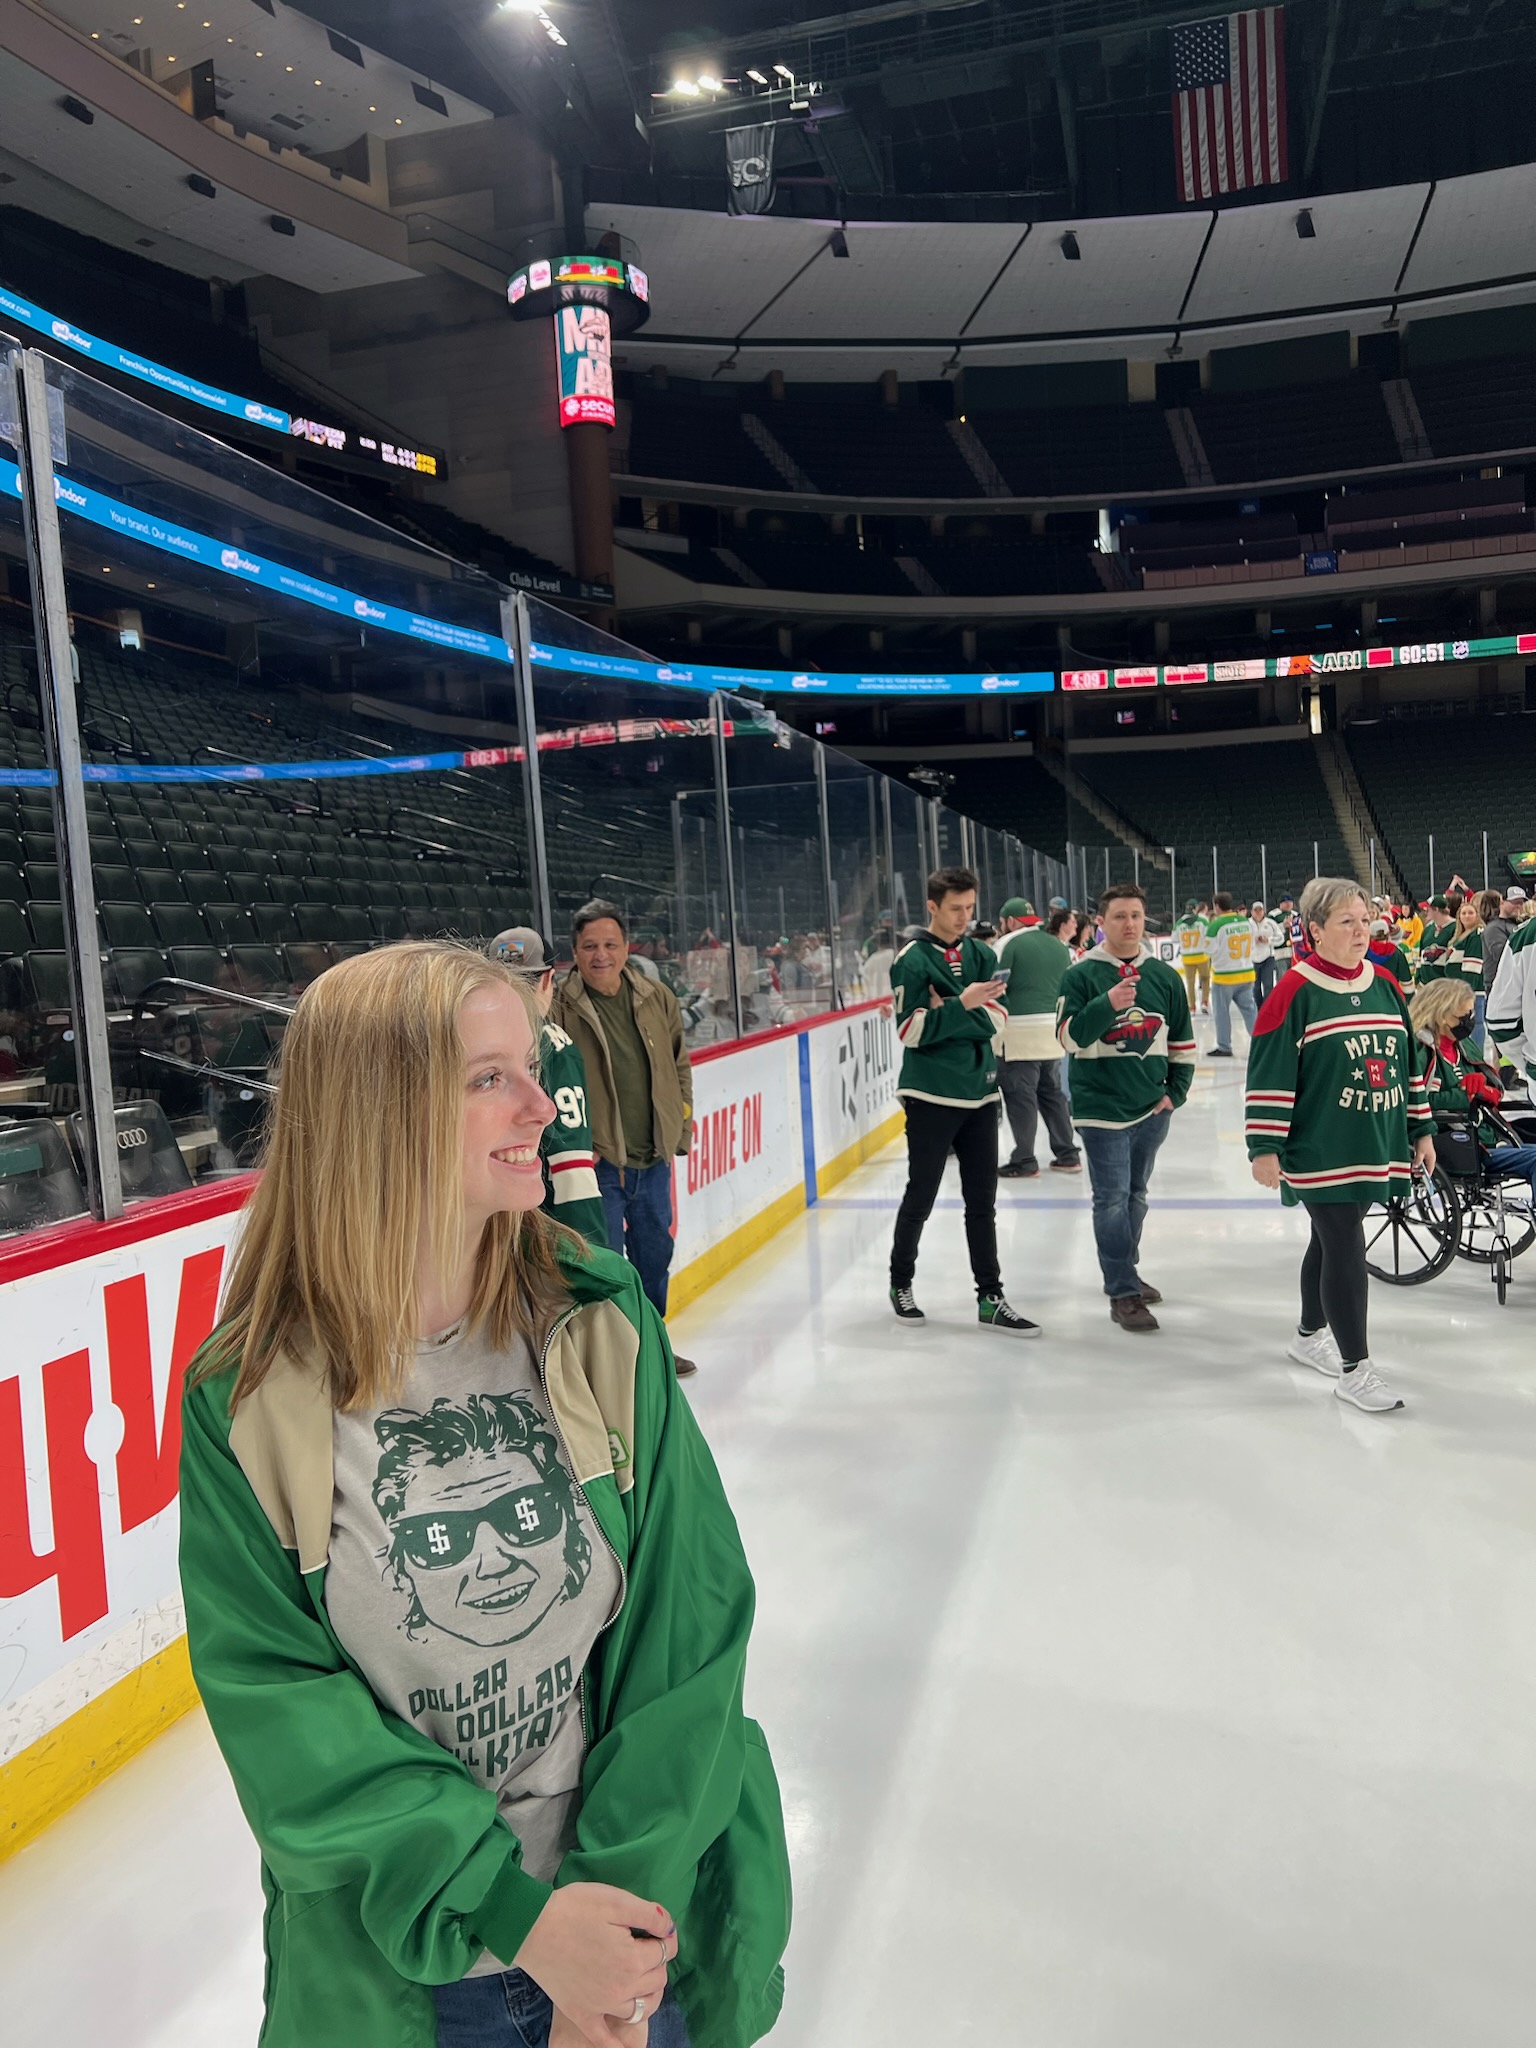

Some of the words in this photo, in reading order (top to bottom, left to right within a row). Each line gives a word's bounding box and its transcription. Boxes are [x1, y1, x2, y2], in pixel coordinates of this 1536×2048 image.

[109, 509, 127, 526] Your
[509, 572, 532, 587] Club
[532, 576, 562, 593] Level
[1180, 929, 1201, 948] 97
[1228, 933, 1252, 960] 97
[1344, 1033, 1399, 1060] MPLS.
[554, 1085, 588, 1129] 97
[687, 1103, 737, 1196] GAME
[742, 1091, 762, 1163] ON
[408, 1657, 508, 1719] DOLLAR
[456, 1655, 574, 1743] DOLLAR
